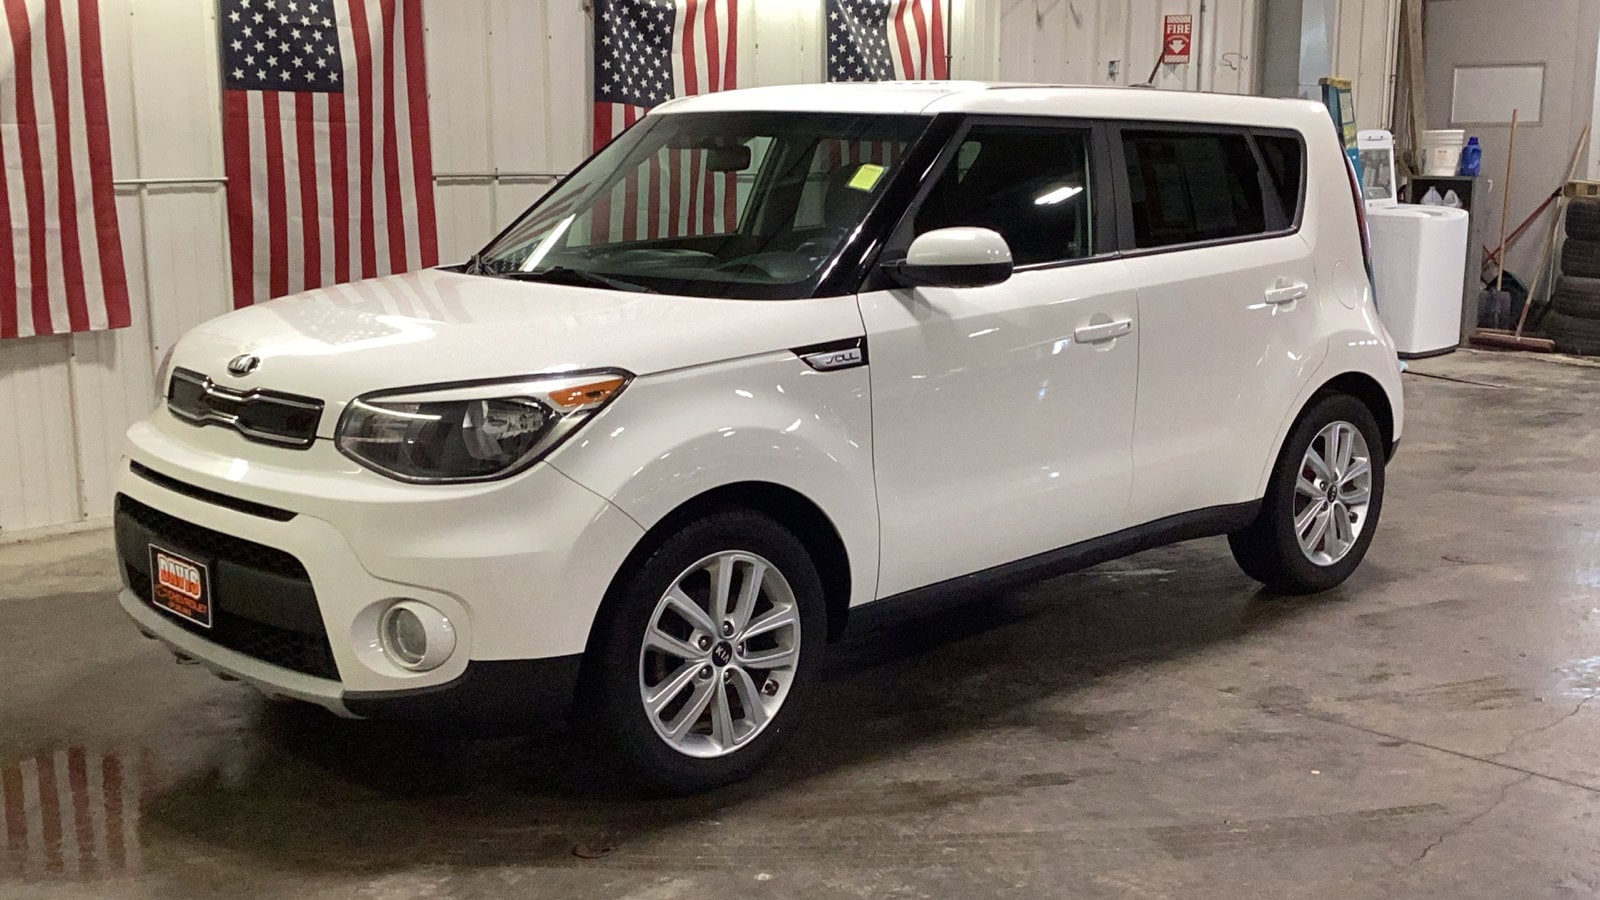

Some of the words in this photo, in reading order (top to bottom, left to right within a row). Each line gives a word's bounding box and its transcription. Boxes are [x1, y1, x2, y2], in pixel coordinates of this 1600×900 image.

[1166, 23, 1191, 34] FIRE
[158, 554, 201, 599] DAVIS
[715, 645, 731, 664] KIA
